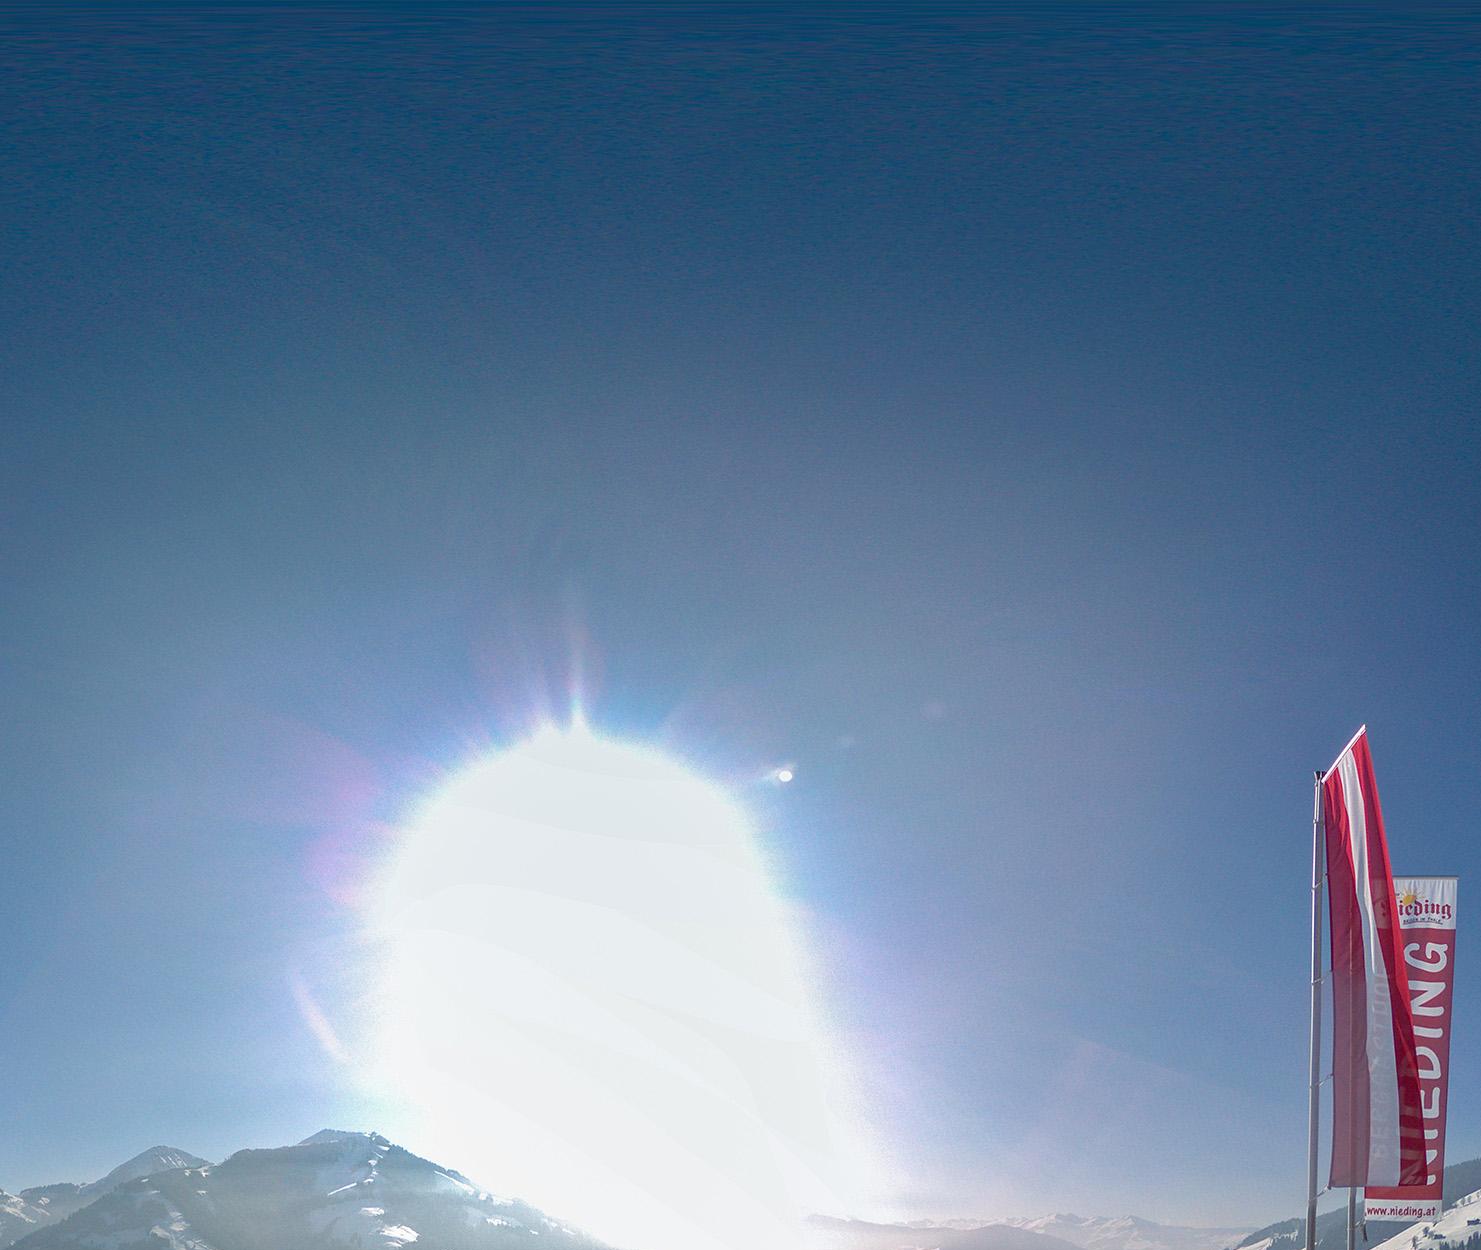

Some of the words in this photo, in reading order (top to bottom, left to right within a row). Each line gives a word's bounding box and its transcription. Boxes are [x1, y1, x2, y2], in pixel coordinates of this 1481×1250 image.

[1398, 899, 1451, 920] ieding
[1400, 942, 1449, 1186] NIEDING
[1367, 1206, 1436, 1218] www.nieding.at
